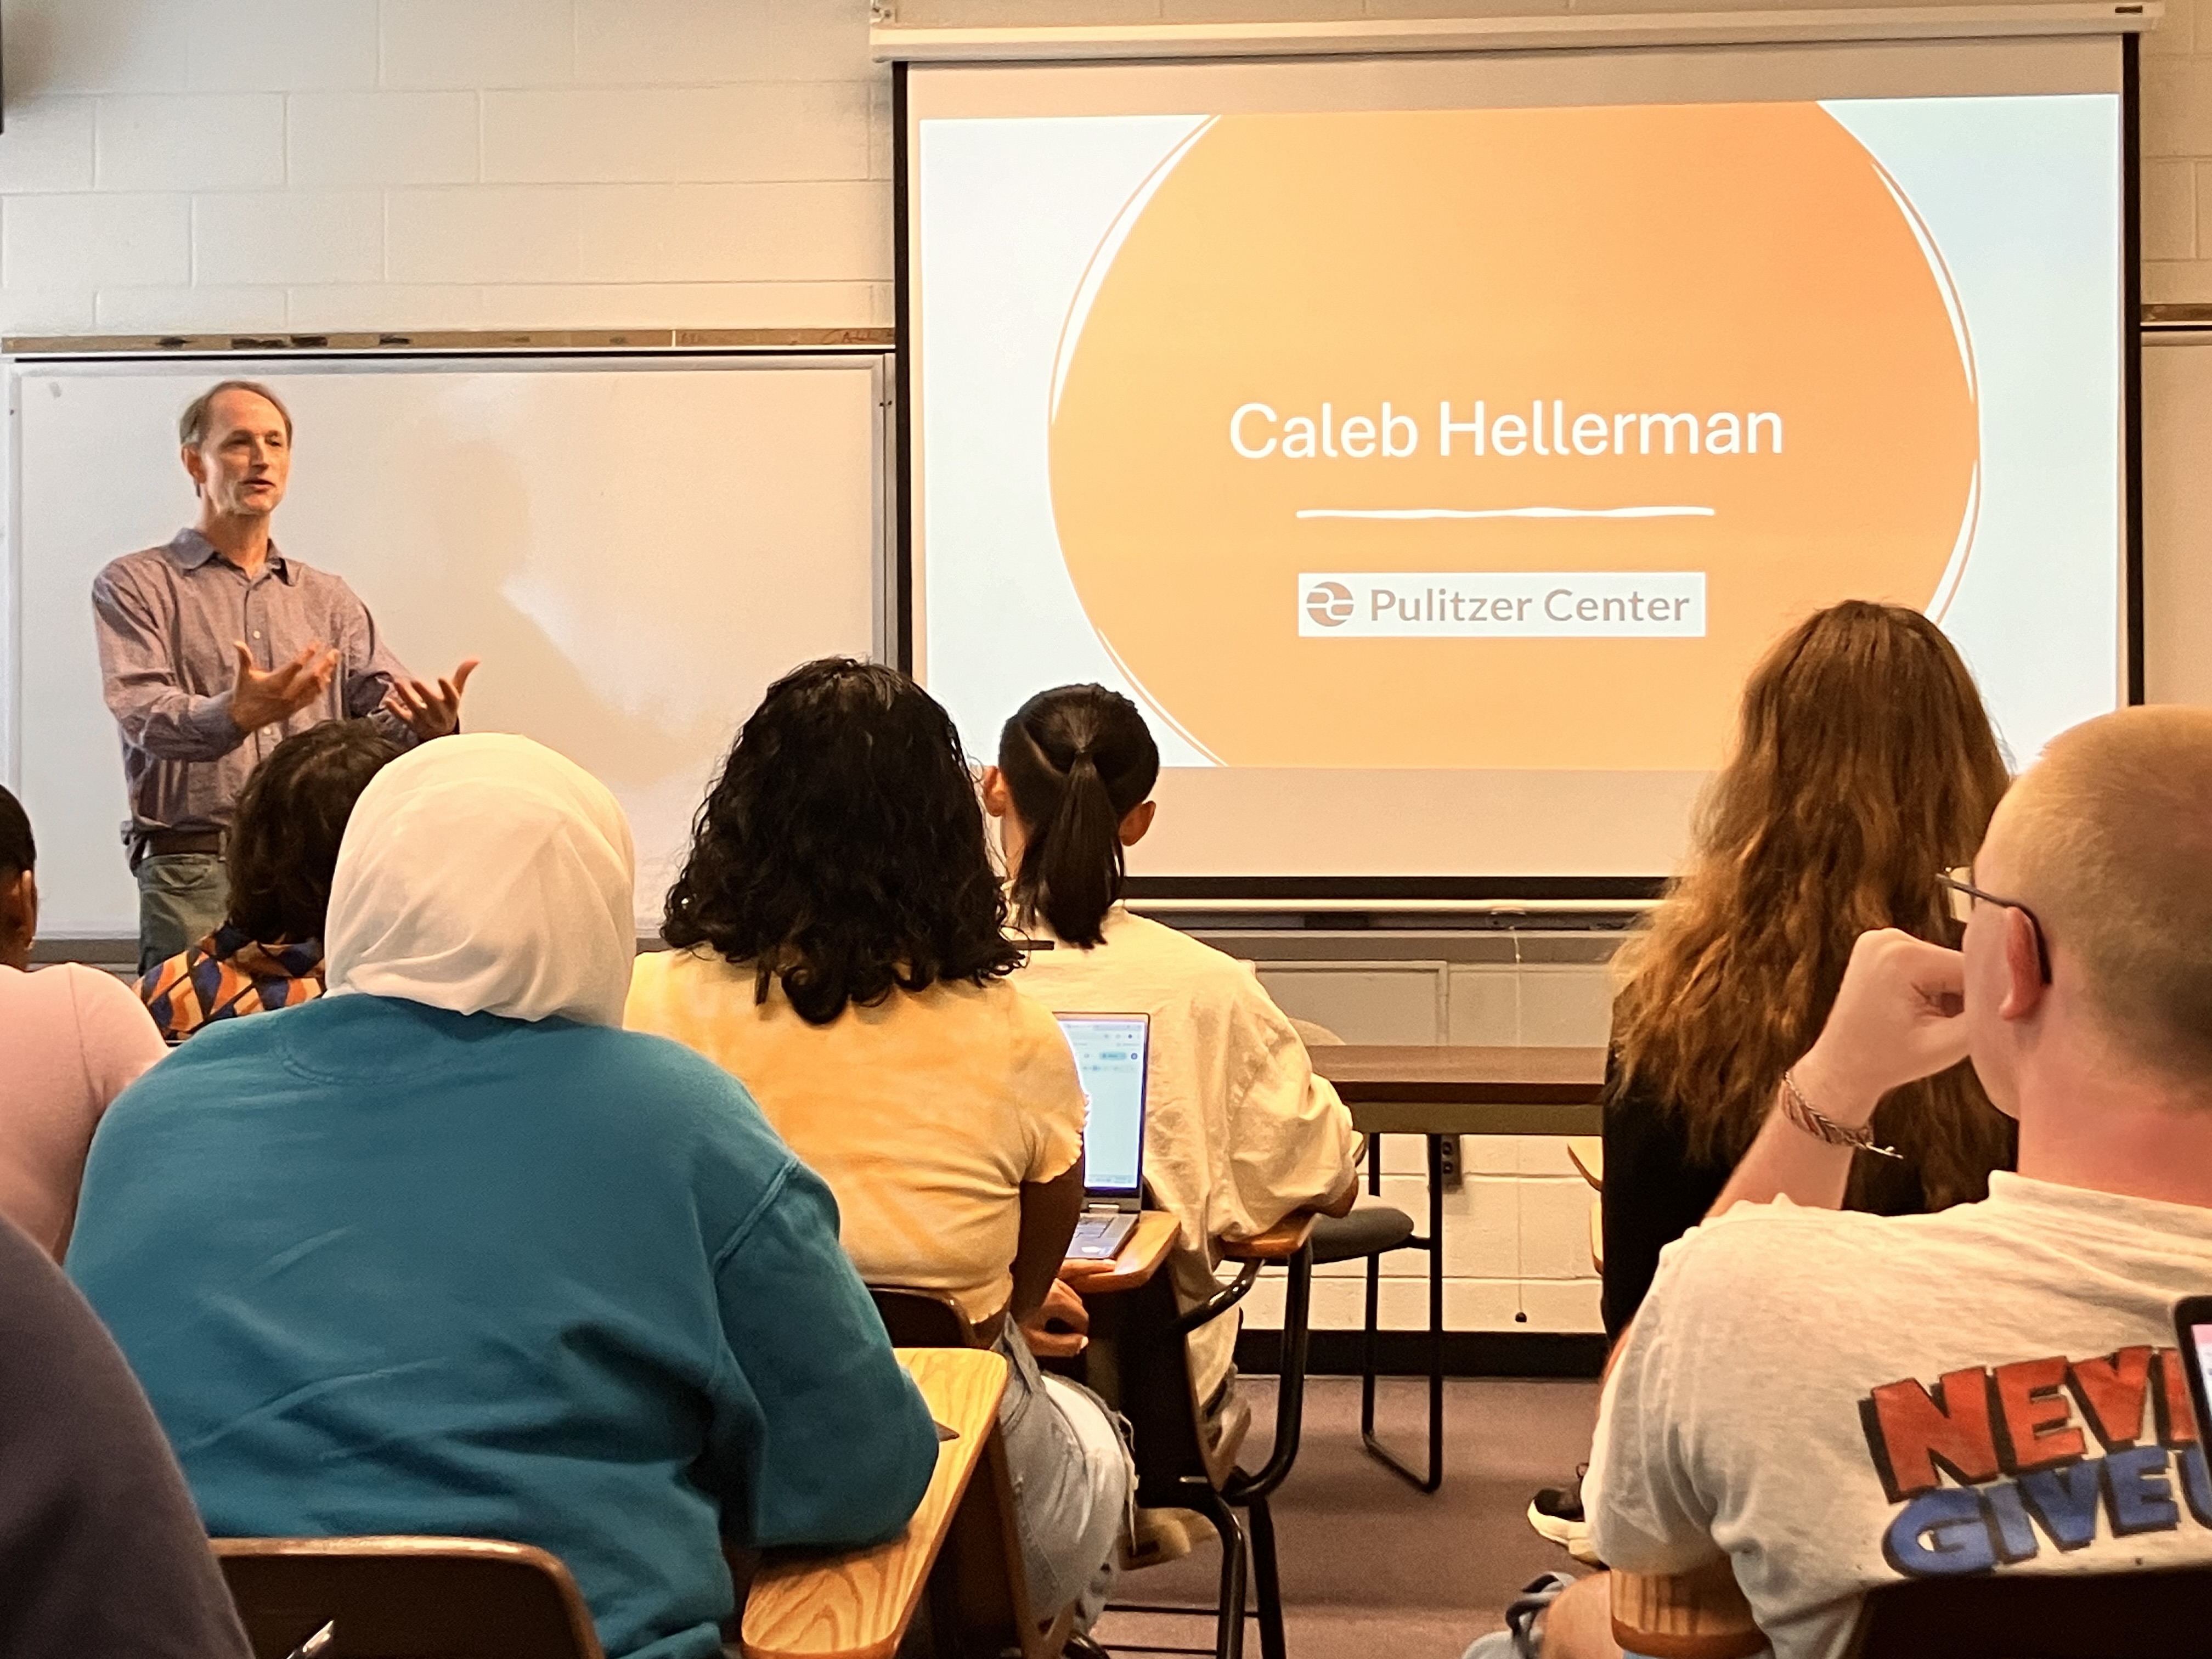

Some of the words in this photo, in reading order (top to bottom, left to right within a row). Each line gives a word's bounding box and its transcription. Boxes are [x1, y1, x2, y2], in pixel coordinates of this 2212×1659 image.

[1231, 402, 1418, 459] Caleb
[1441, 400, 1781, 456] Hellerman
[1372, 589, 1532, 620] Pulitzer
[1545, 590, 1689, 620] Center
